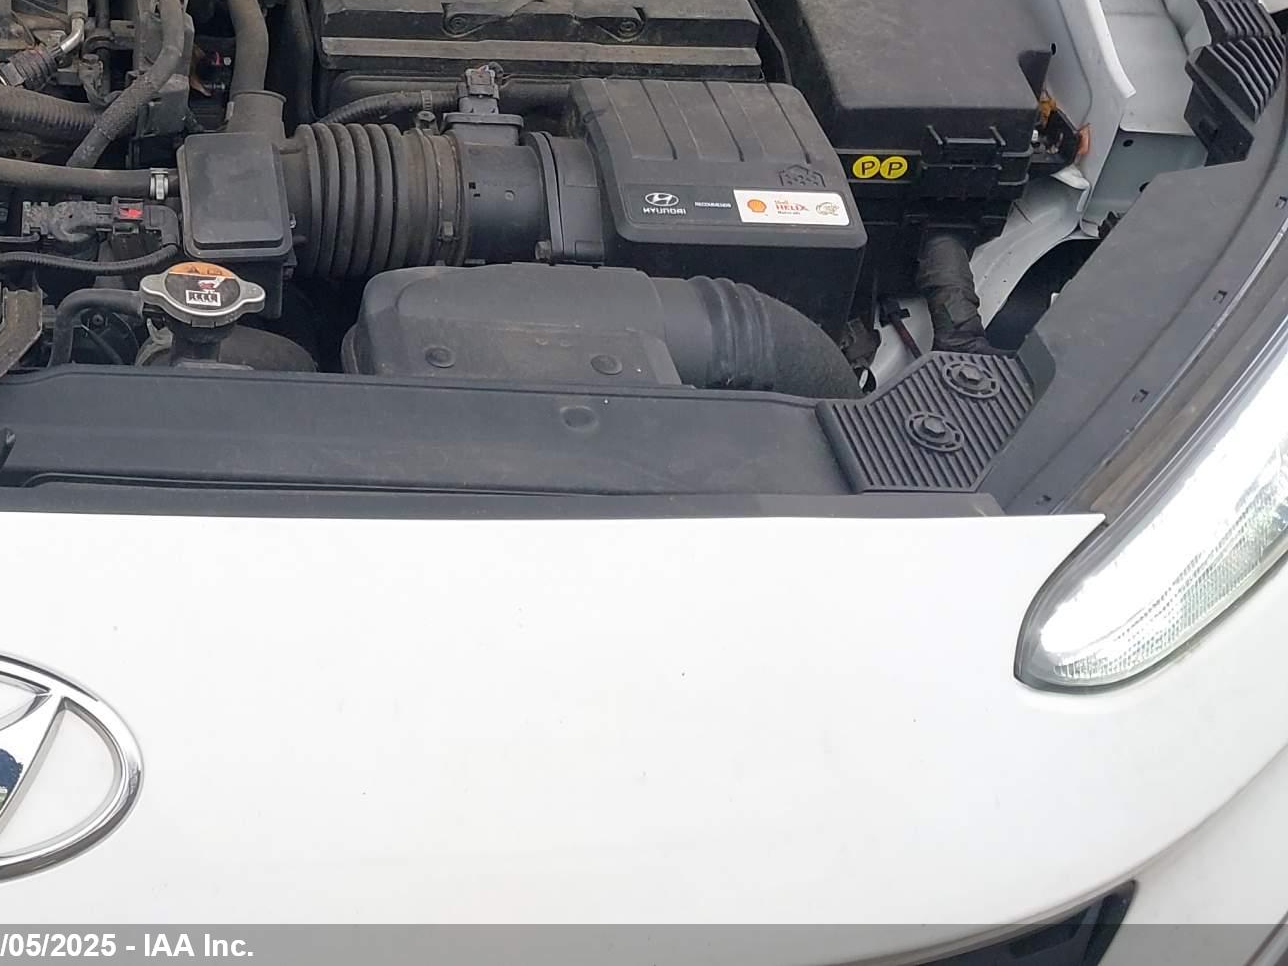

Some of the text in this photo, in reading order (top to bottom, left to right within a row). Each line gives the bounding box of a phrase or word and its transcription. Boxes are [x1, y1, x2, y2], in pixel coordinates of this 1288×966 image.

[861, 160, 903, 176] P P
[642, 207, 687, 215] HYUNDAI
[775, 203, 810, 212] HELIX
